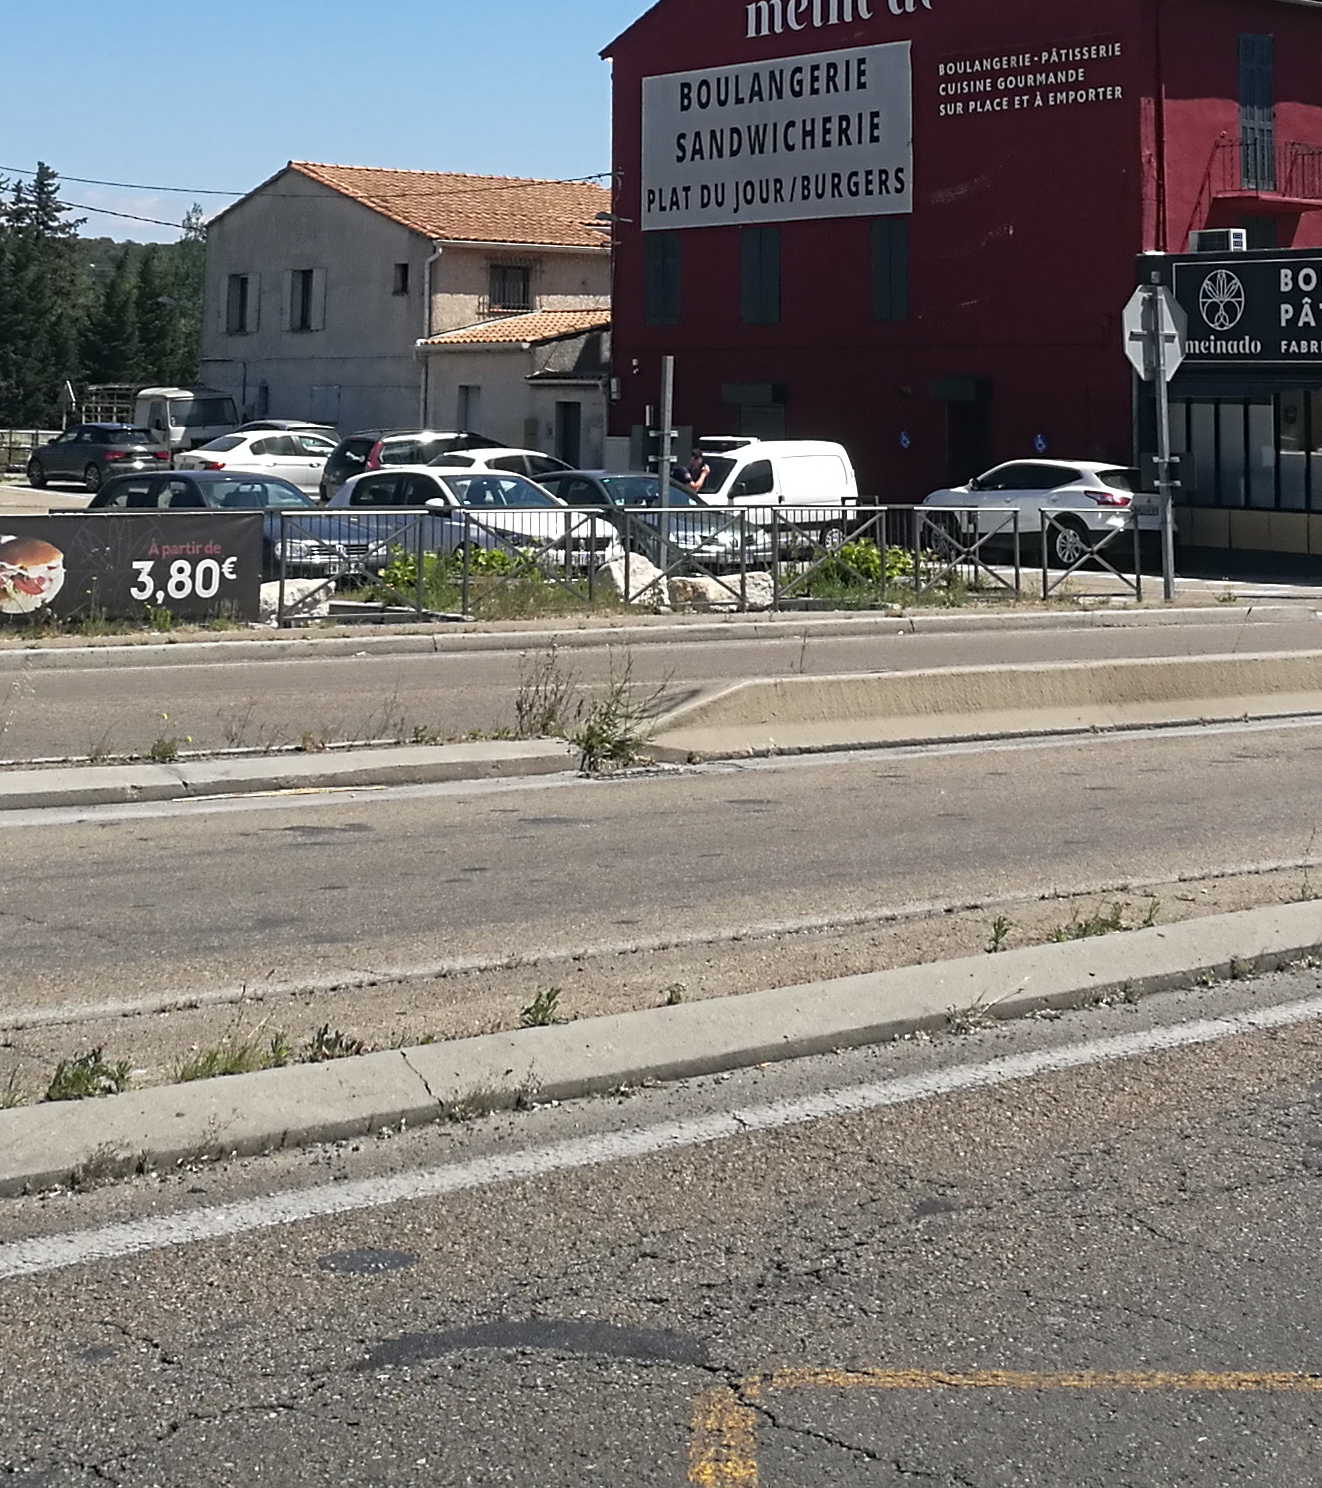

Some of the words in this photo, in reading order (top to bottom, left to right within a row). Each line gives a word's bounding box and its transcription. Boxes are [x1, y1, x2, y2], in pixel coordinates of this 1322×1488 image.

[679, 57, 868, 112] BOULANGERIE
[939, 78, 993, 96] CUISINE
[997, 68, 1086, 90] GOURMANDE
[939, 102, 964, 117] SUR
[968, 97, 1009, 113] PLACE
[1014, 95, 1030, 109] ET
[1034, 91, 1044, 108] À
[1048, 85, 1123, 106] EMPORTER
[675, 110, 881, 163] SANDWICHERIE
[647, 185, 692, 213] PLAT
[700, 182, 726, 209] DU
[1185, 334, 1262, 355] meinado
[161, 541, 202, 558] partir
[204, 539, 222, 554] de
[130, 556, 238, 604] 3,80€
